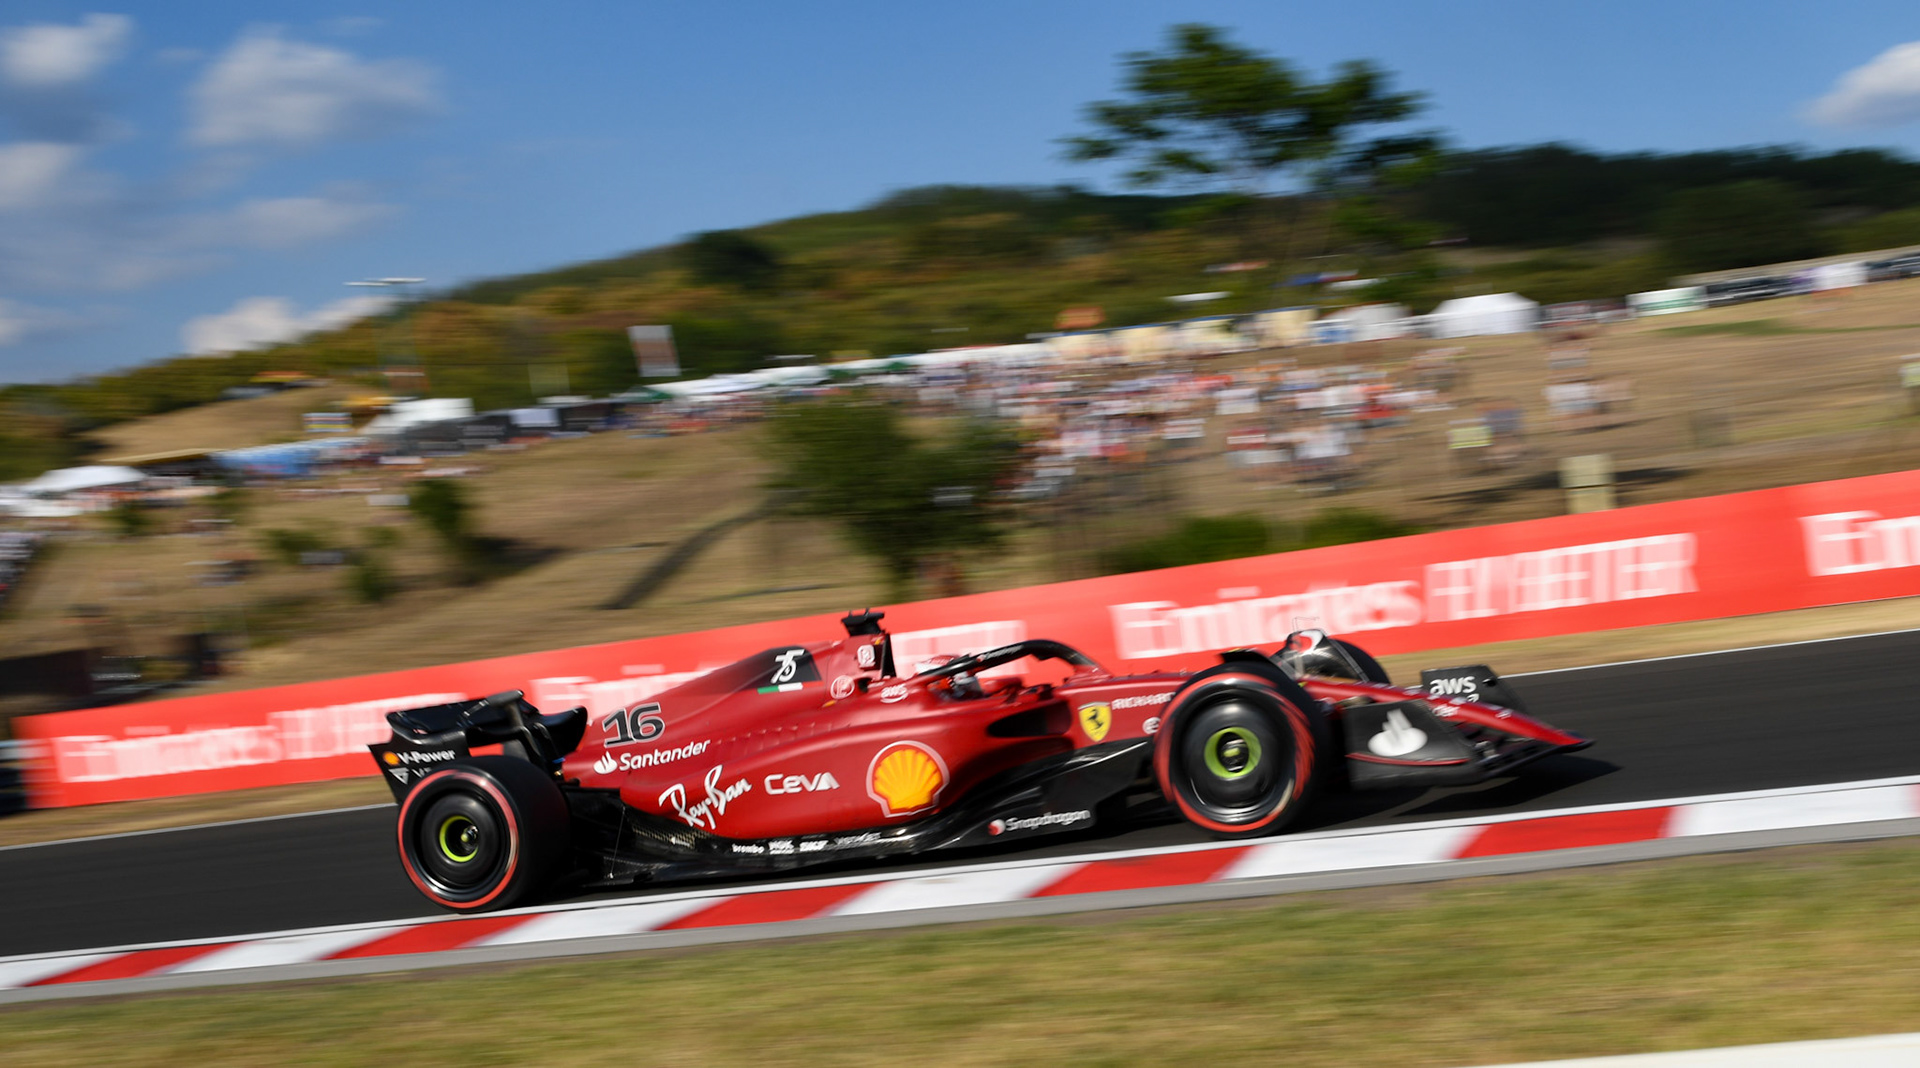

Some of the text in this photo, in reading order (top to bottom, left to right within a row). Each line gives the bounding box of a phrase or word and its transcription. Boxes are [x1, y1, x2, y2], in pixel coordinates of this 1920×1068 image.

[1429, 676, 1477, 696] aws
[602, 702, 665, 748] 16
[396, 749, 456, 765] V-Power
[619, 739, 711, 771] Santander
[1005, 809, 1091, 831] Snapdragon
